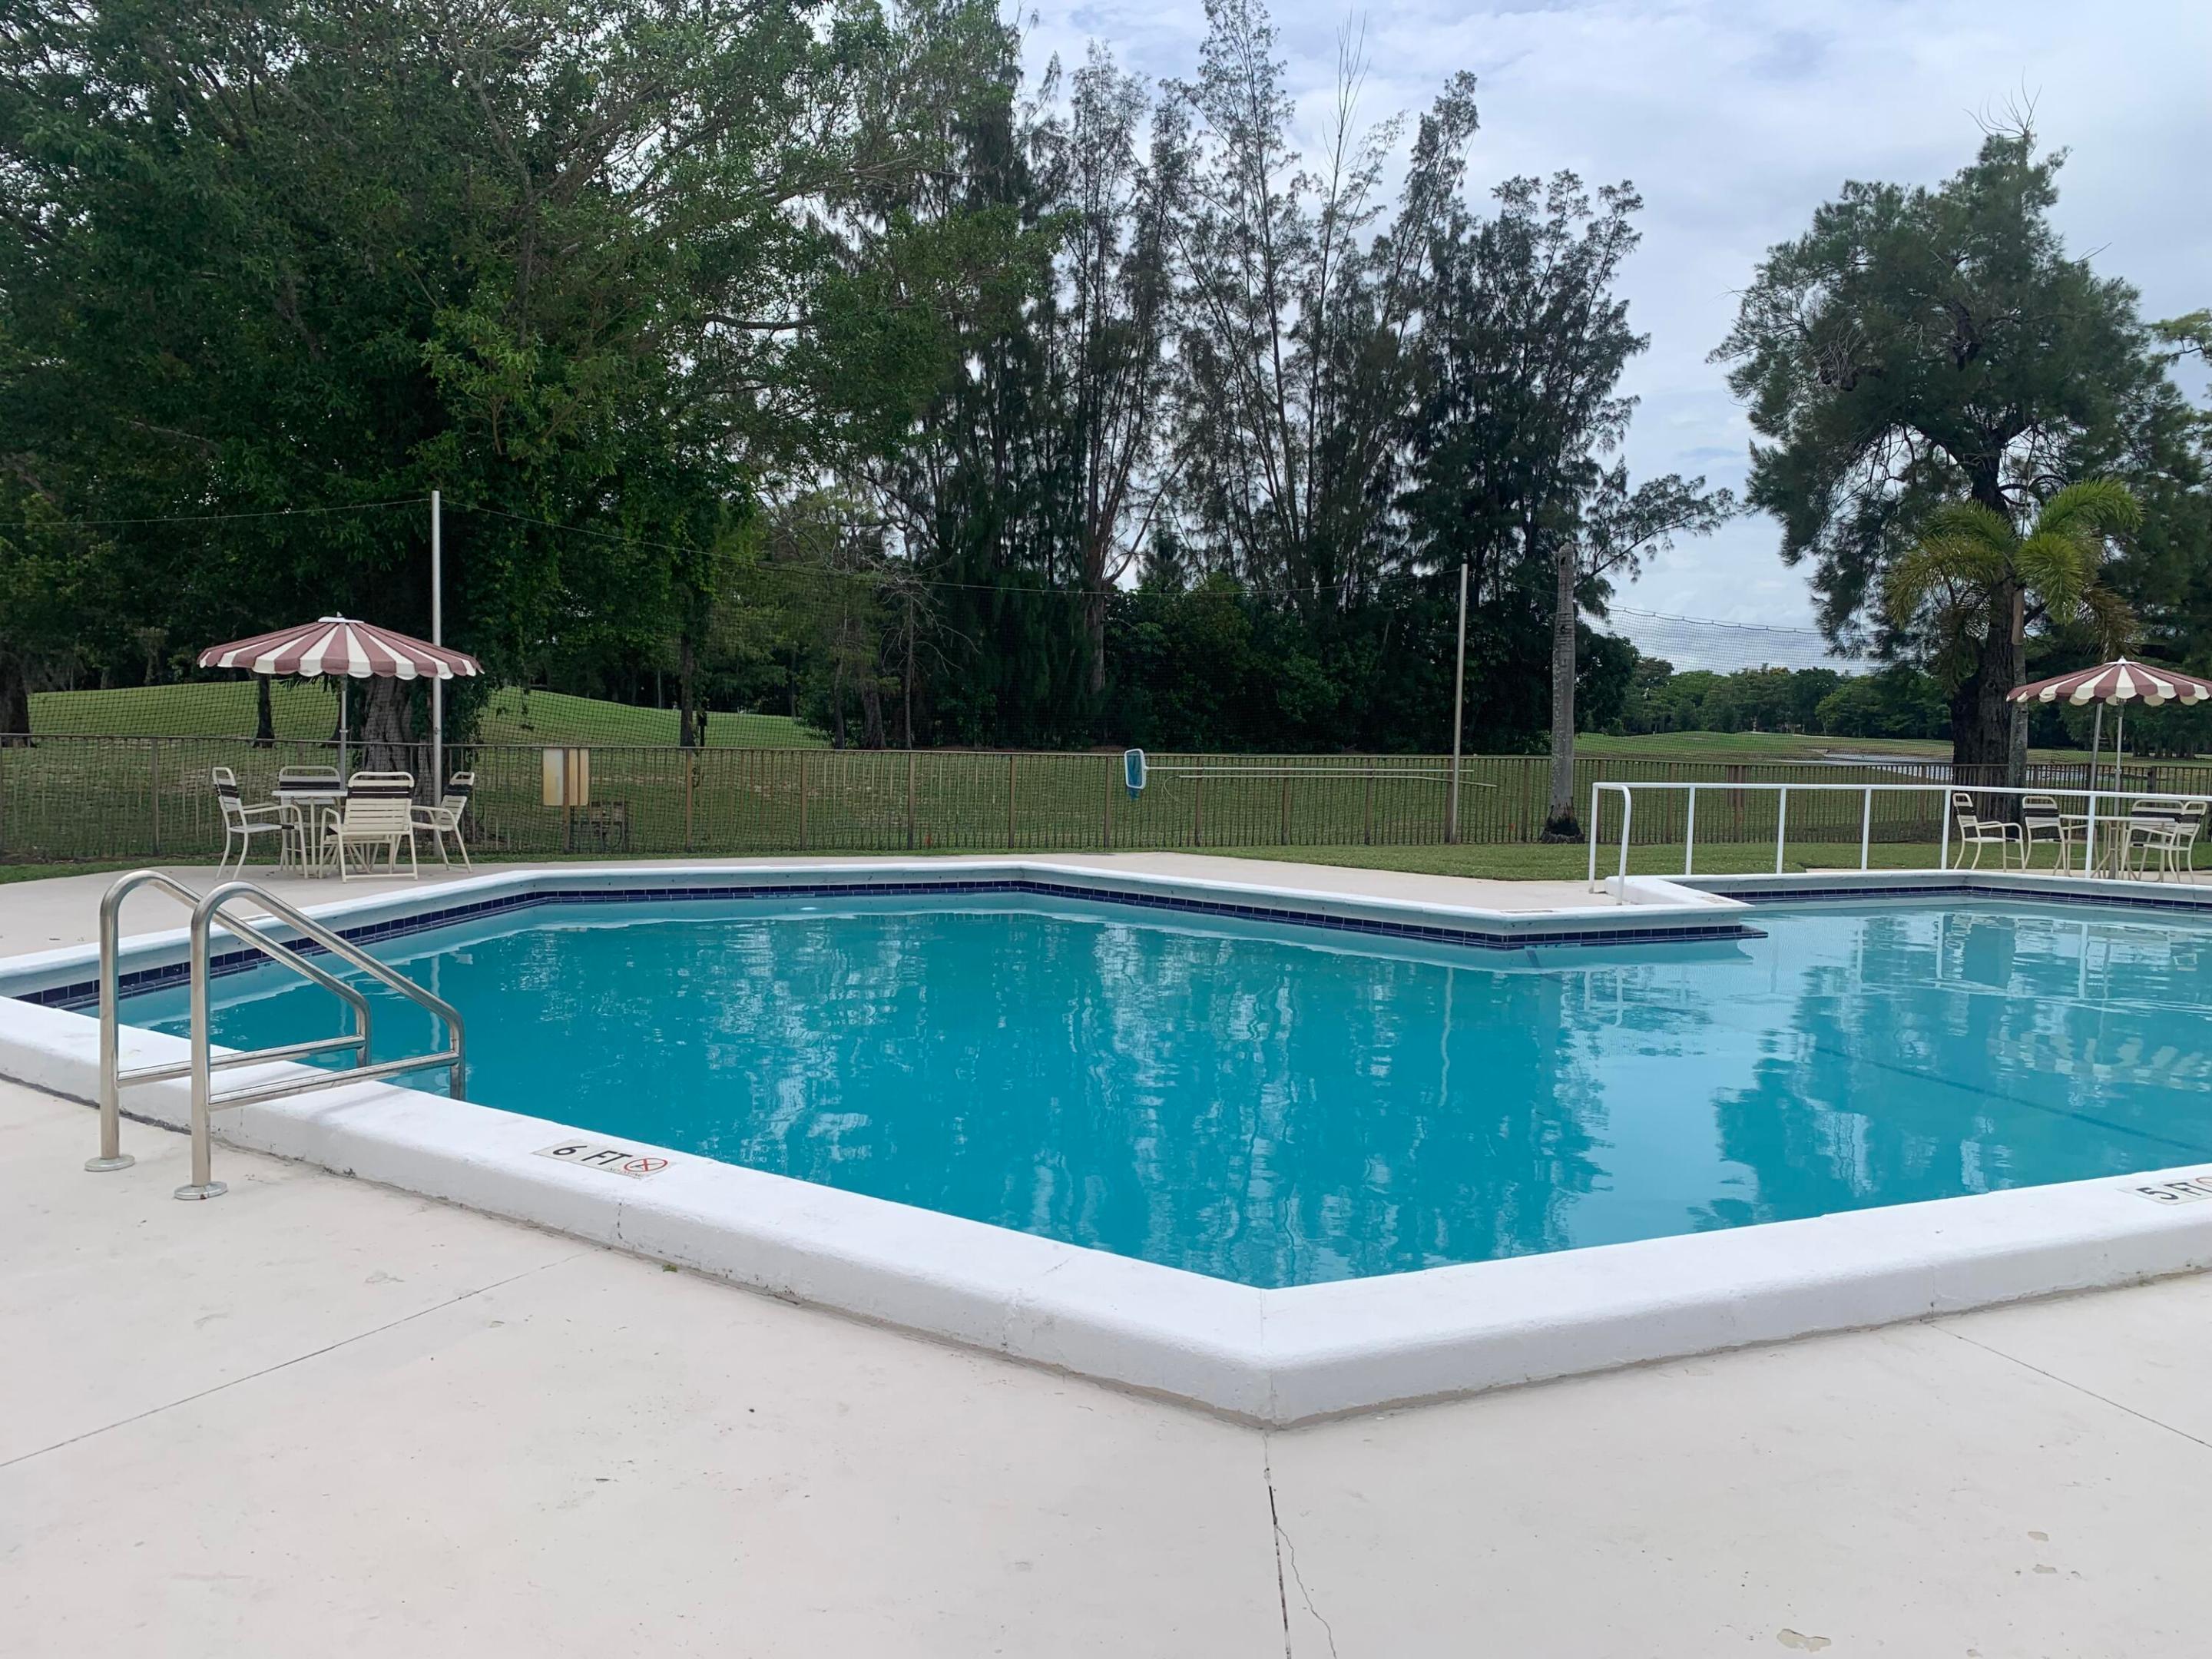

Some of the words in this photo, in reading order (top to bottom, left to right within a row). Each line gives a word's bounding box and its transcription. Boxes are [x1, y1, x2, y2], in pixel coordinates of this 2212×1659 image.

[552, 1145, 588, 1155] 6
[581, 1150, 633, 1165] FT
[2135, 1187, 2179, 1200] 5
